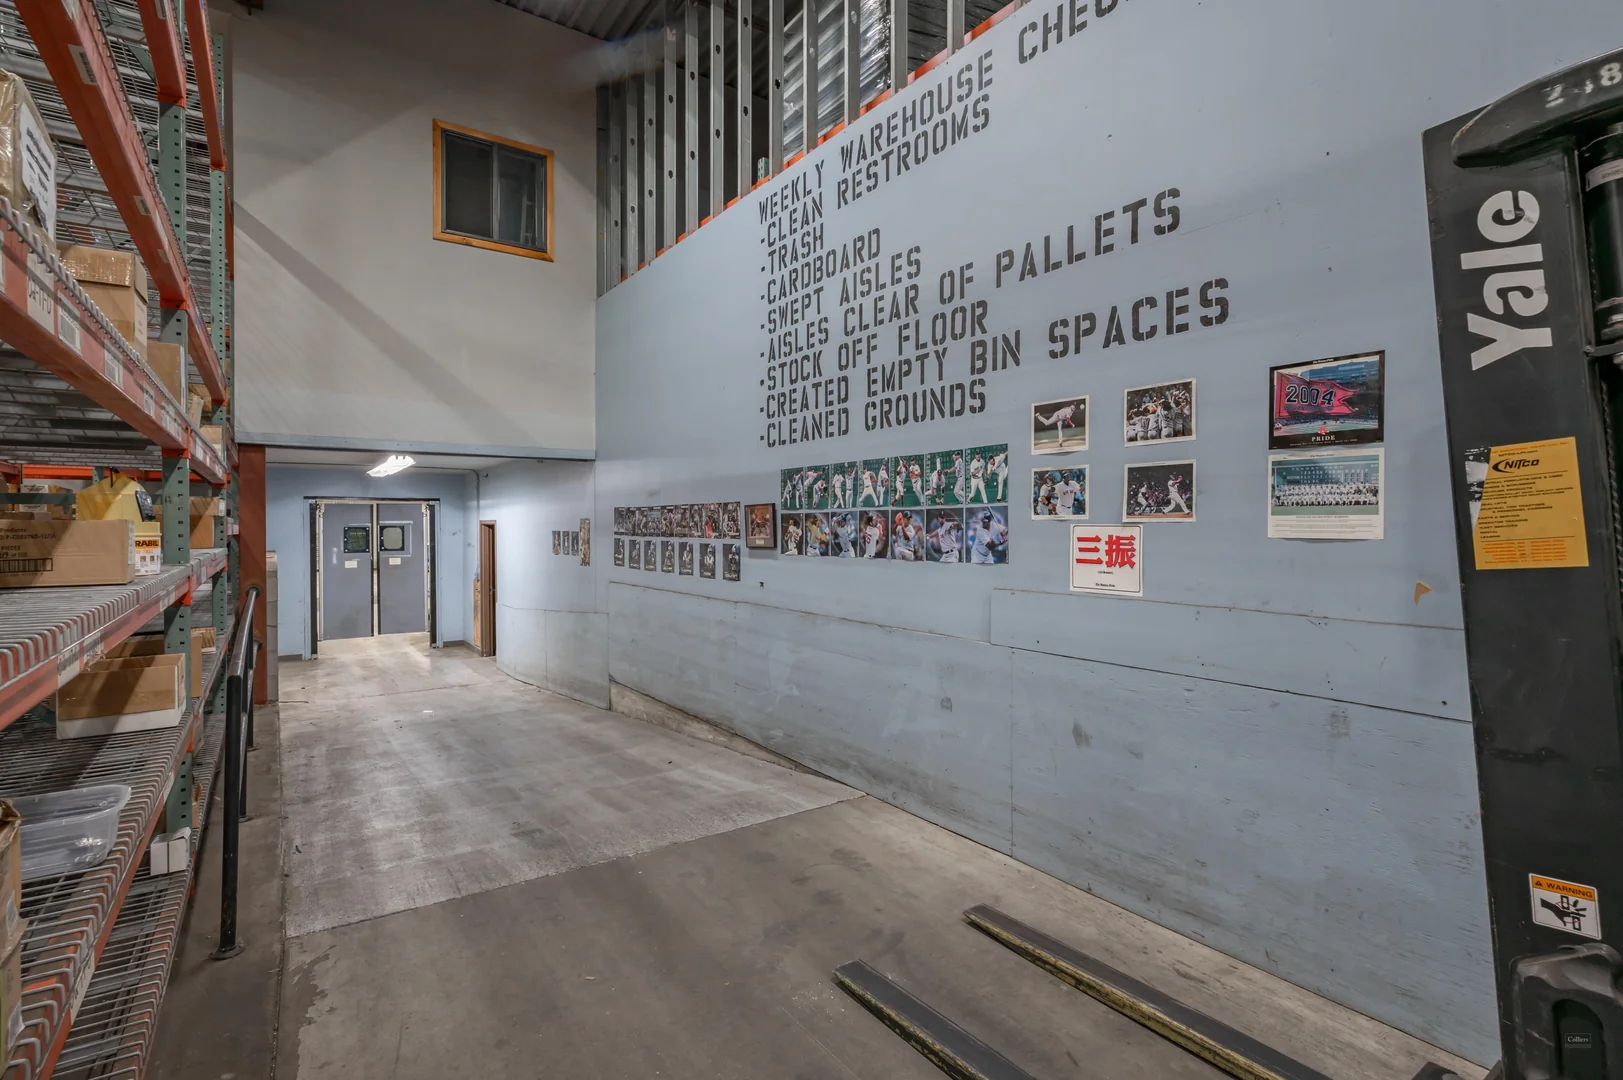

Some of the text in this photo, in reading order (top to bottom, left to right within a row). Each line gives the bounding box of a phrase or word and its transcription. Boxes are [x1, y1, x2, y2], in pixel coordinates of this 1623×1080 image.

[759, 0, 1128, 225] WEEKLY WAREHOUSE CHE
[837, 94, 989, 209] RESTROOMS
[839, 246, 921, 306] AISLES
[844, 284, 919, 337] CLEAR
[940, 262, 973, 305] OF
[996, 188, 1180, 288] PALLETS
[1460, 190, 1553, 371] Yale
[838, 333, 877, 371] OFF
[898, 300, 987, 356] FLOOR
[867, 347, 948, 397] EMPTY
[970, 330, 1020, 376] BIN
[1049, 278, 1229, 359] SPACES
[865, 378, 986, 431] GROUNDS
[1286, 384, 1336, 407] 2004
[1504, 459, 1540, 470] NITCO
[1075, 534, 1137, 569] 三振
[1546, 882, 1593, 899] WARNING
